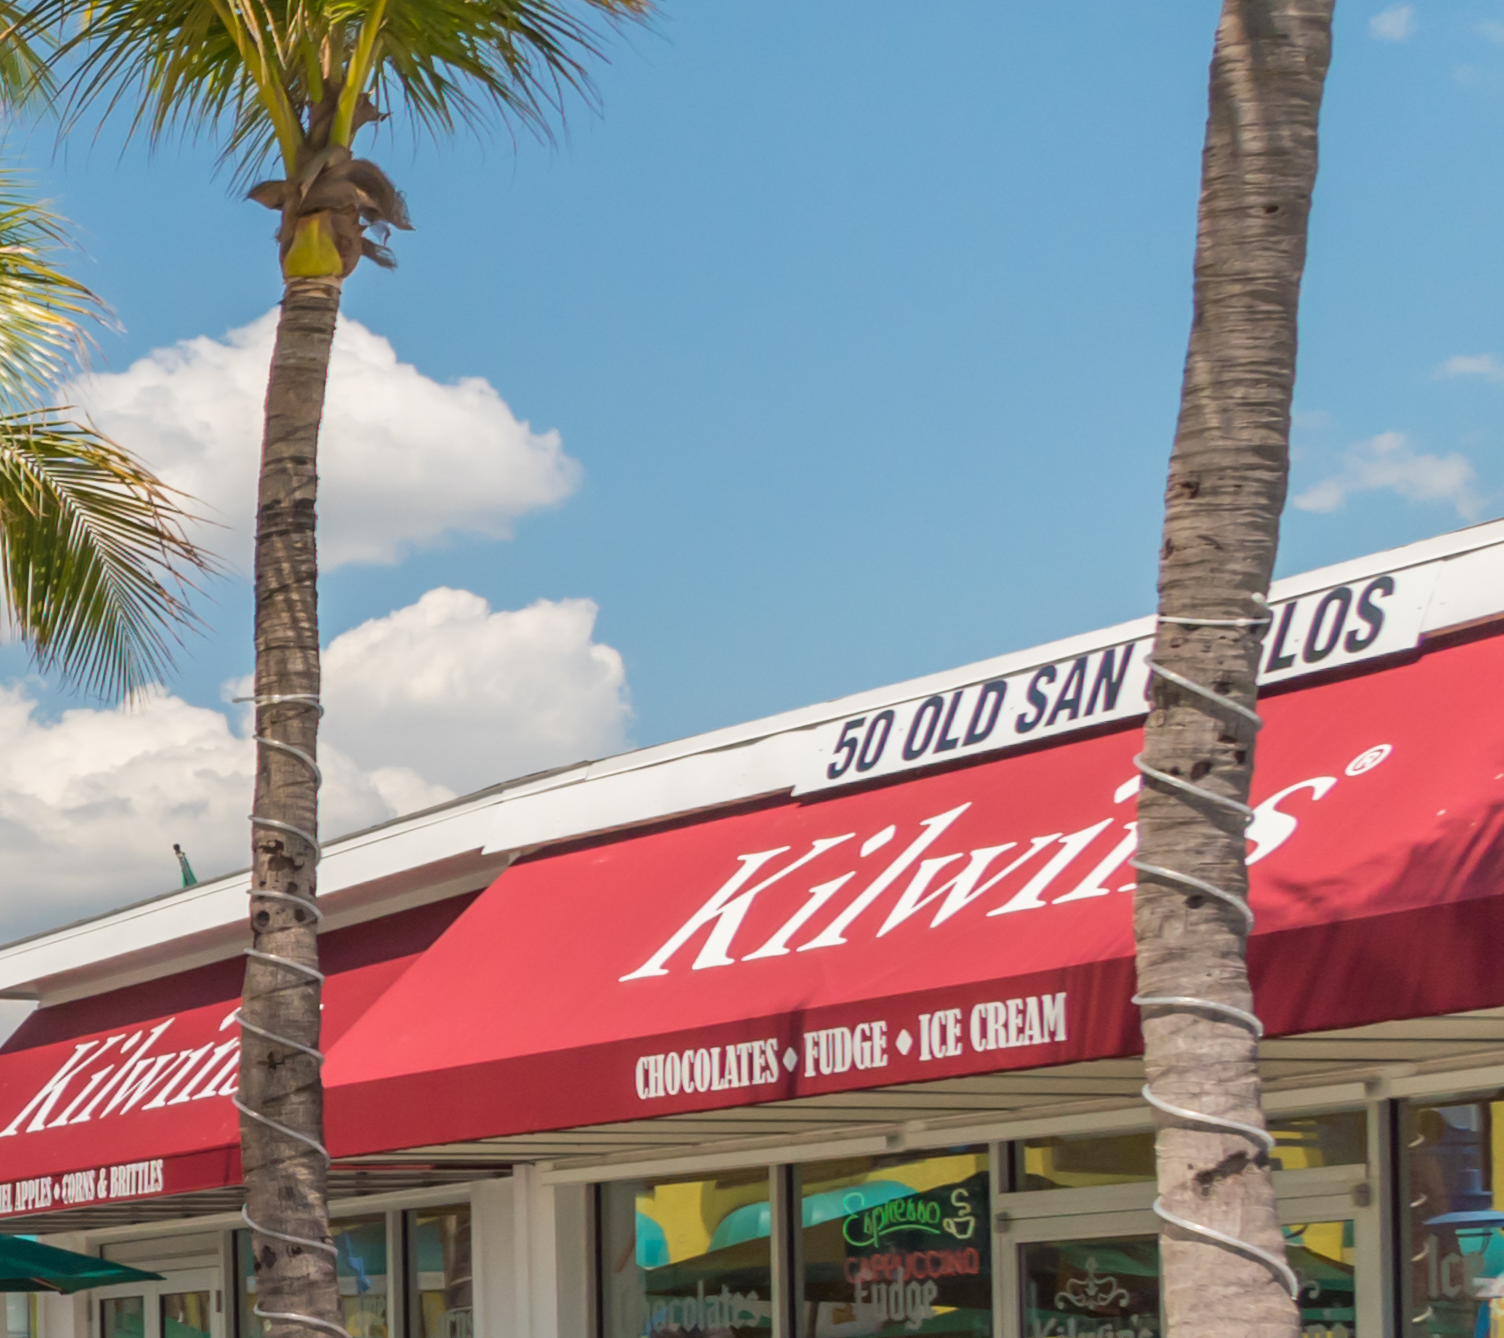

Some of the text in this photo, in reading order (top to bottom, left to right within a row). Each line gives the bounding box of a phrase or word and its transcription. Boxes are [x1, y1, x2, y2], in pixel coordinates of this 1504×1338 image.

[827, 709, 895, 780] 50
[902, 679, 1008, 762] OLD
[1015, 644, 1135, 734] SAN
[619, 775, 1338, 982] Kilwis
[634, 992, 1068, 1100] CHOCOLATES FUDGE ICE CREAM
[14, 1176, 52, 1211] APPLES
[61, 1169, 96, 1204] CORNS
[110, 1159, 164, 1198] BRITTLES
[854, 1266, 938, 1328] Fudge
